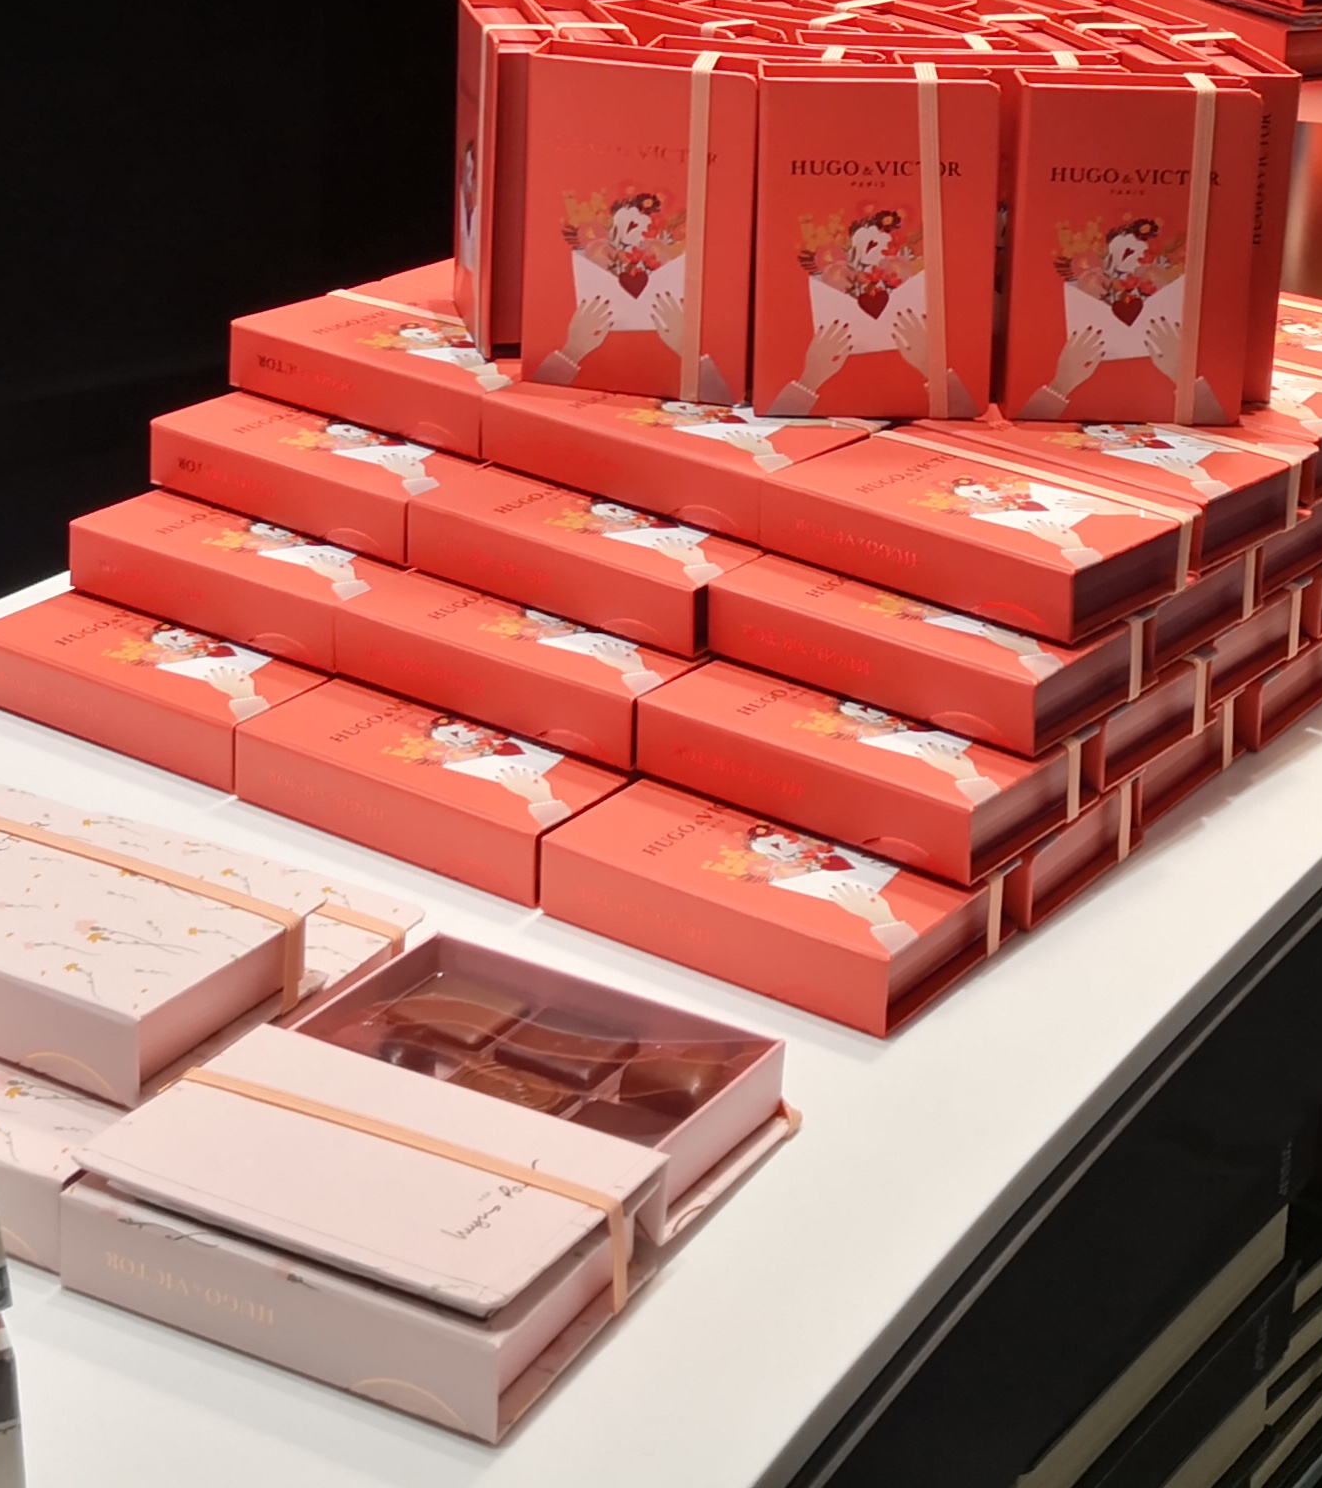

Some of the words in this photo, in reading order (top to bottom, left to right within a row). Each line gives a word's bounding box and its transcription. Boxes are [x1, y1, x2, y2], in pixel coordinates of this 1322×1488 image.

[790, 159, 860, 177] HUGO
[1050, 166, 1120, 184] HUGO
[1135, 169, 1220, 187] VICTR
[855, 473, 906, 495] HUGO
[492, 491, 545, 515] HUGO
[155, 512, 208, 536] HUGO
[54, 618, 110, 647] HUGO
[735, 687, 789, 717] HUGO
[329, 713, 386, 744] HUGO
[641, 822, 697, 858] HUGO
